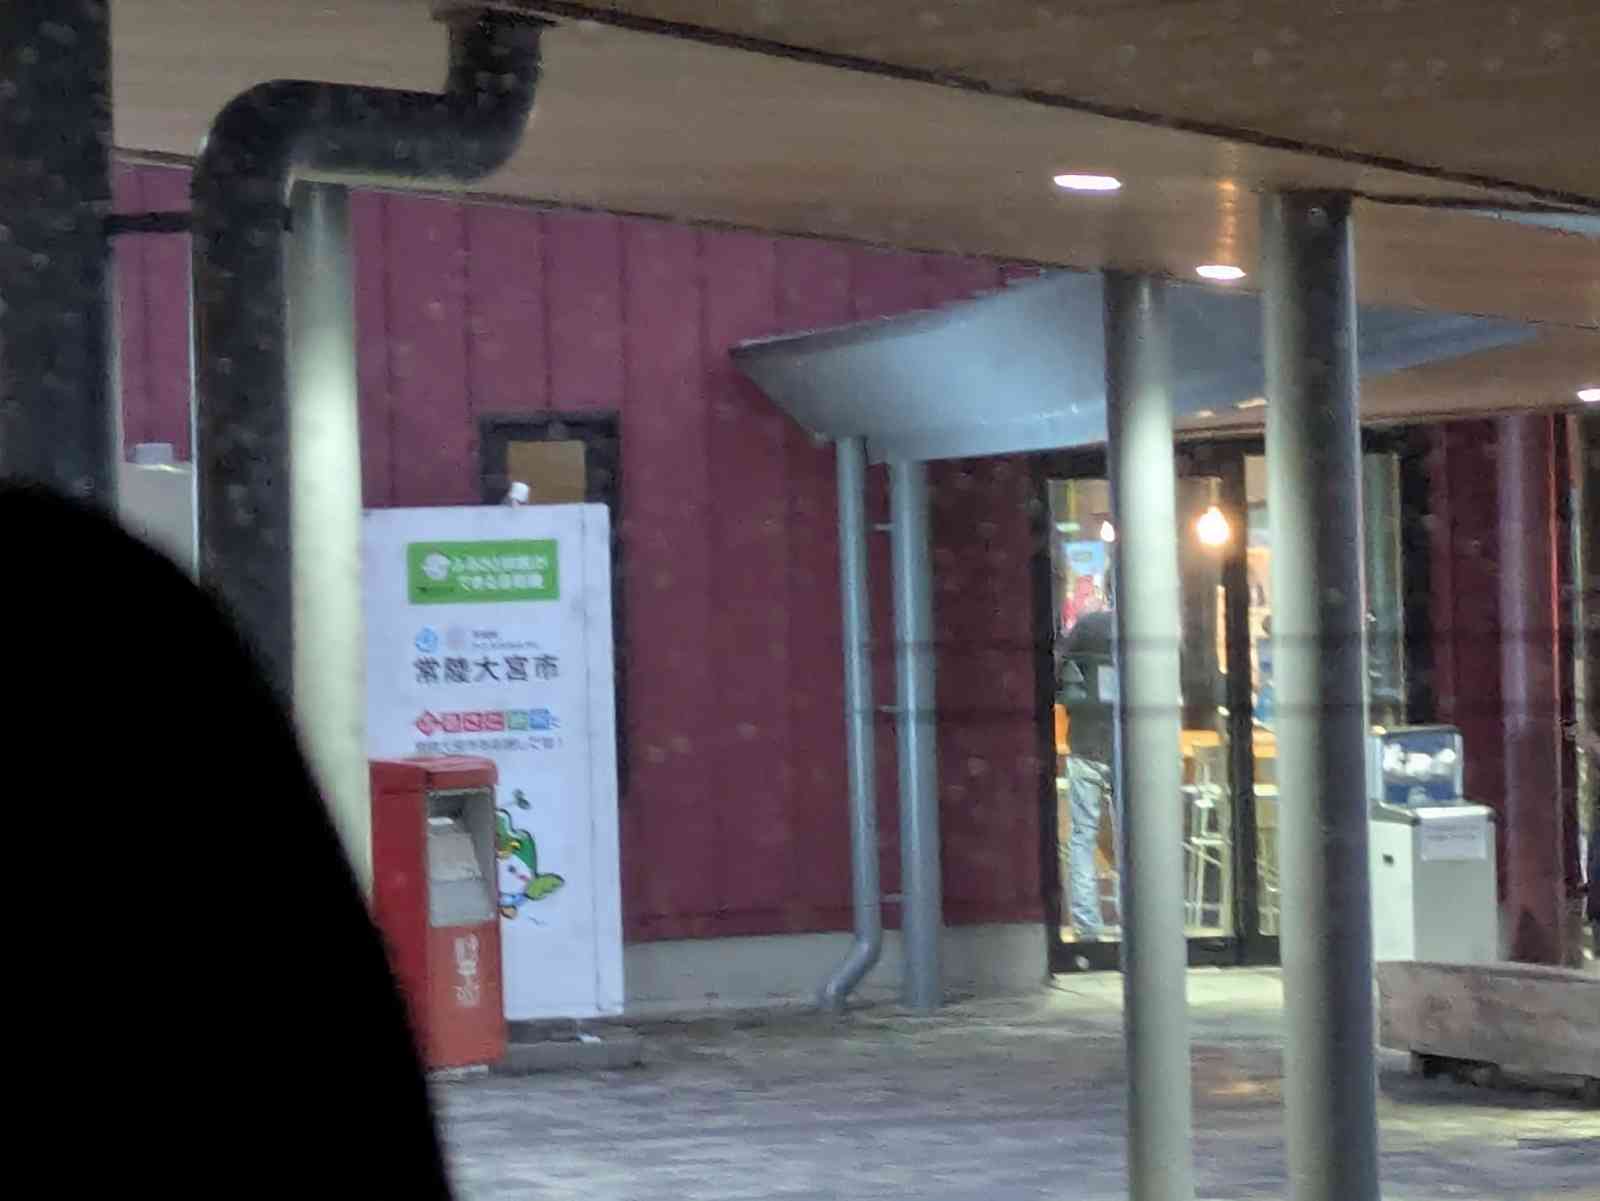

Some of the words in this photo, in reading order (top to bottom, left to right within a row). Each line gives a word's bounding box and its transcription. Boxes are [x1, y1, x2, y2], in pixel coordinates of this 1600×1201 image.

[413, 654, 560, 684] 常陸大宮市
